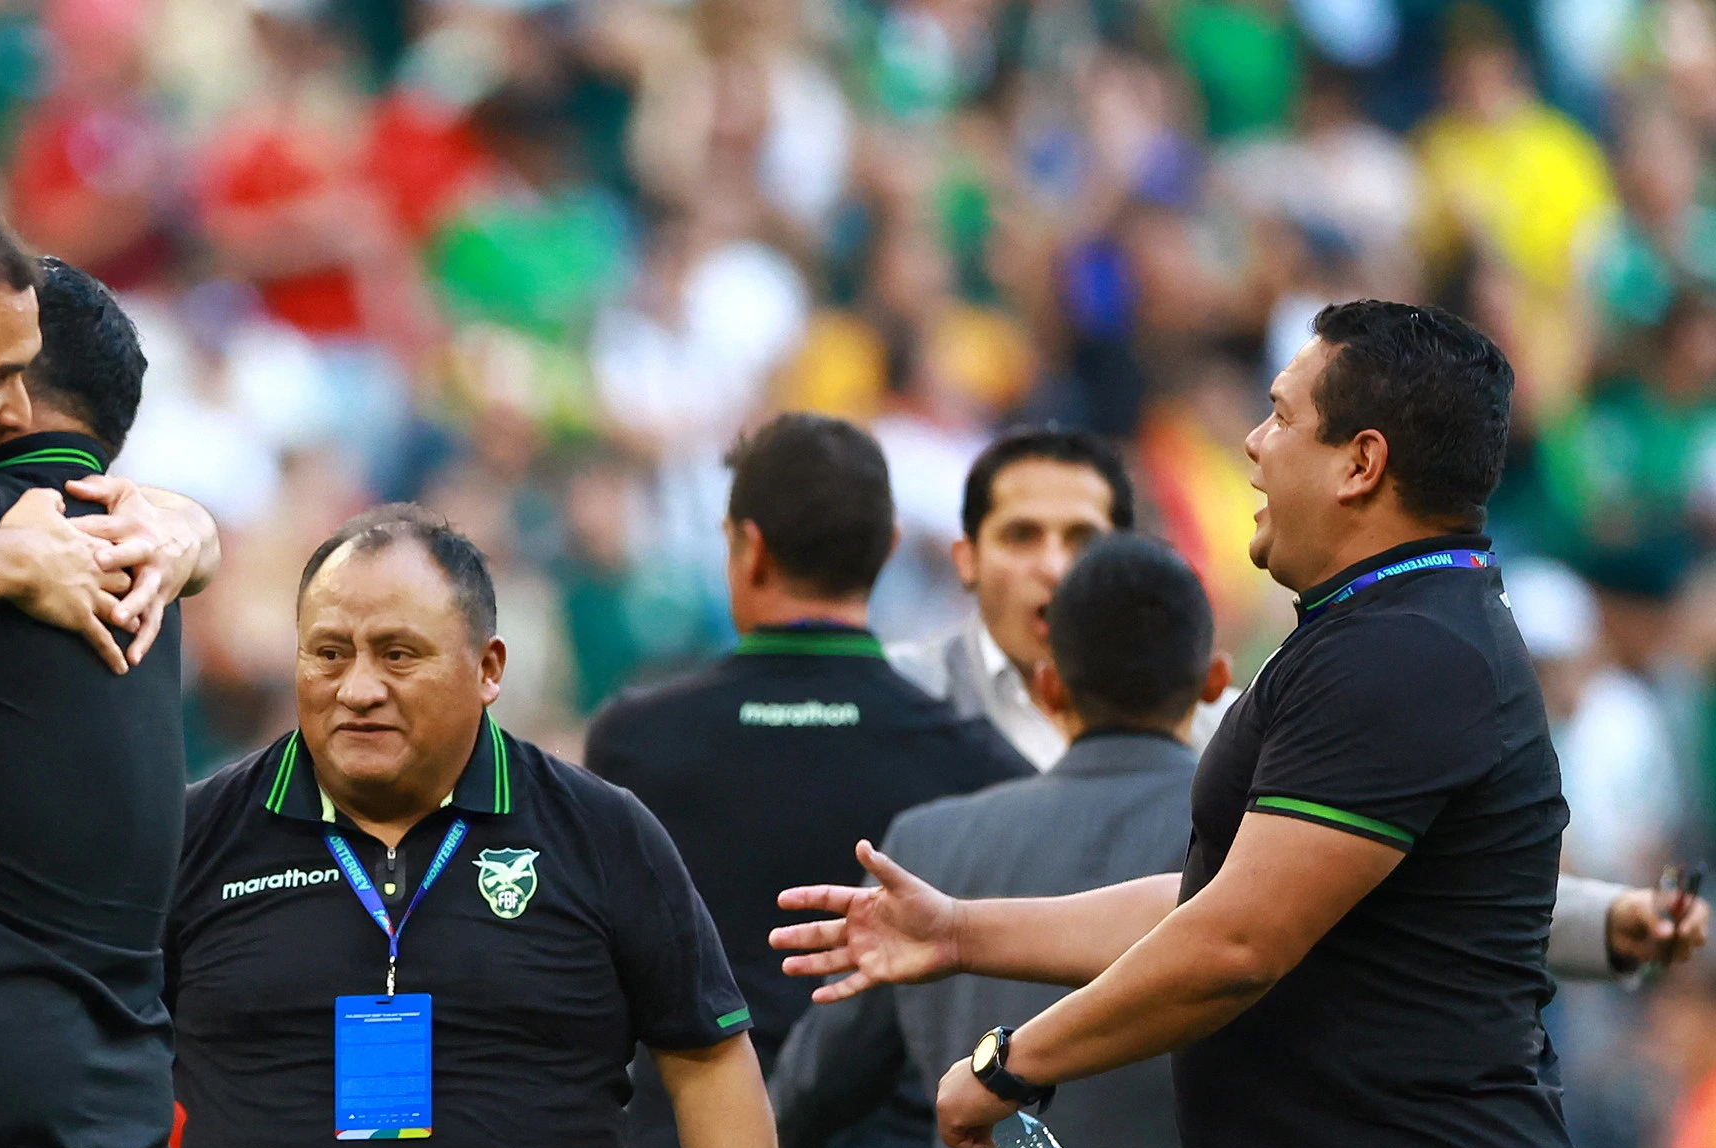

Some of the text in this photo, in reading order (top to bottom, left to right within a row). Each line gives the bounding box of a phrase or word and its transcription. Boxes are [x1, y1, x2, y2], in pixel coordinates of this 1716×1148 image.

[1376, 553, 1454, 581] MONTERREY
[423, 819, 467, 890] MONTERREY
[222, 868, 340, 900] marathon
[497, 890, 519, 910] FBF
